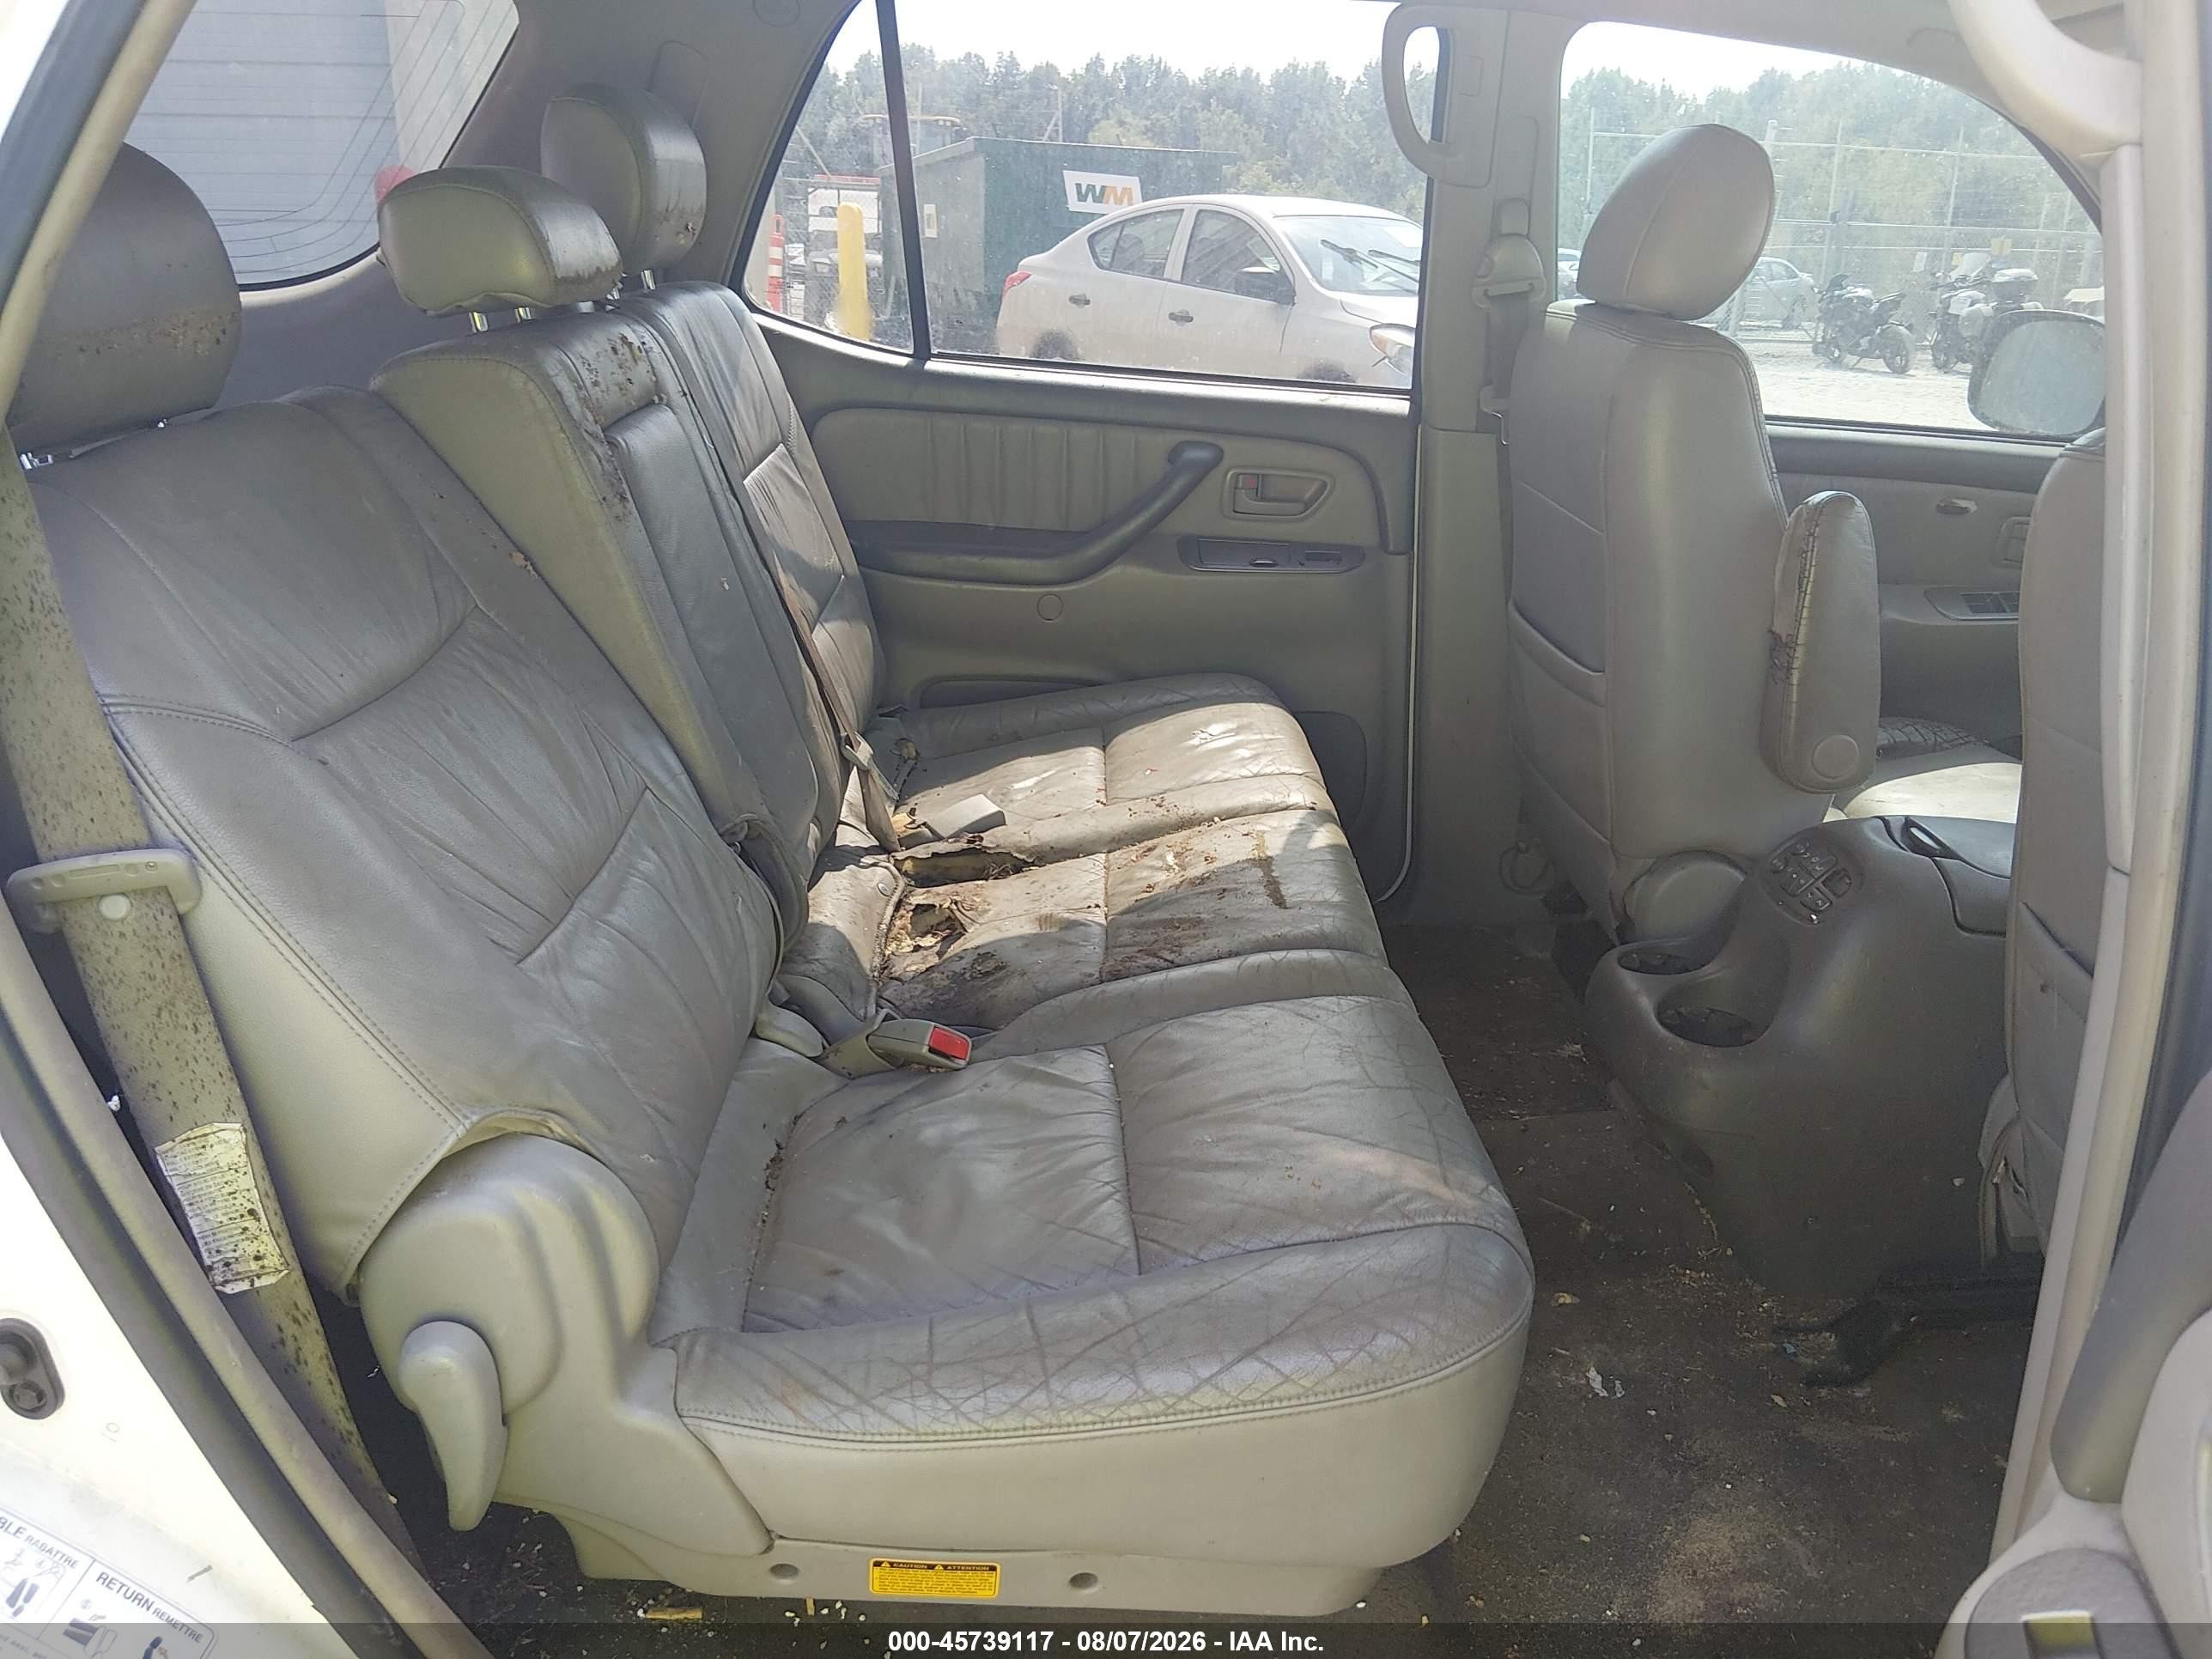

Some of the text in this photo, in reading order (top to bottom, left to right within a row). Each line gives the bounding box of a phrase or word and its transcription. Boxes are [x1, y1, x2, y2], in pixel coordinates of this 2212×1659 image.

[1075, 183, 1133, 205] WM
[24, 1534, 79, 1569] RABATTRE
[96, 1571, 204, 1644] RETURN REMETTRE
